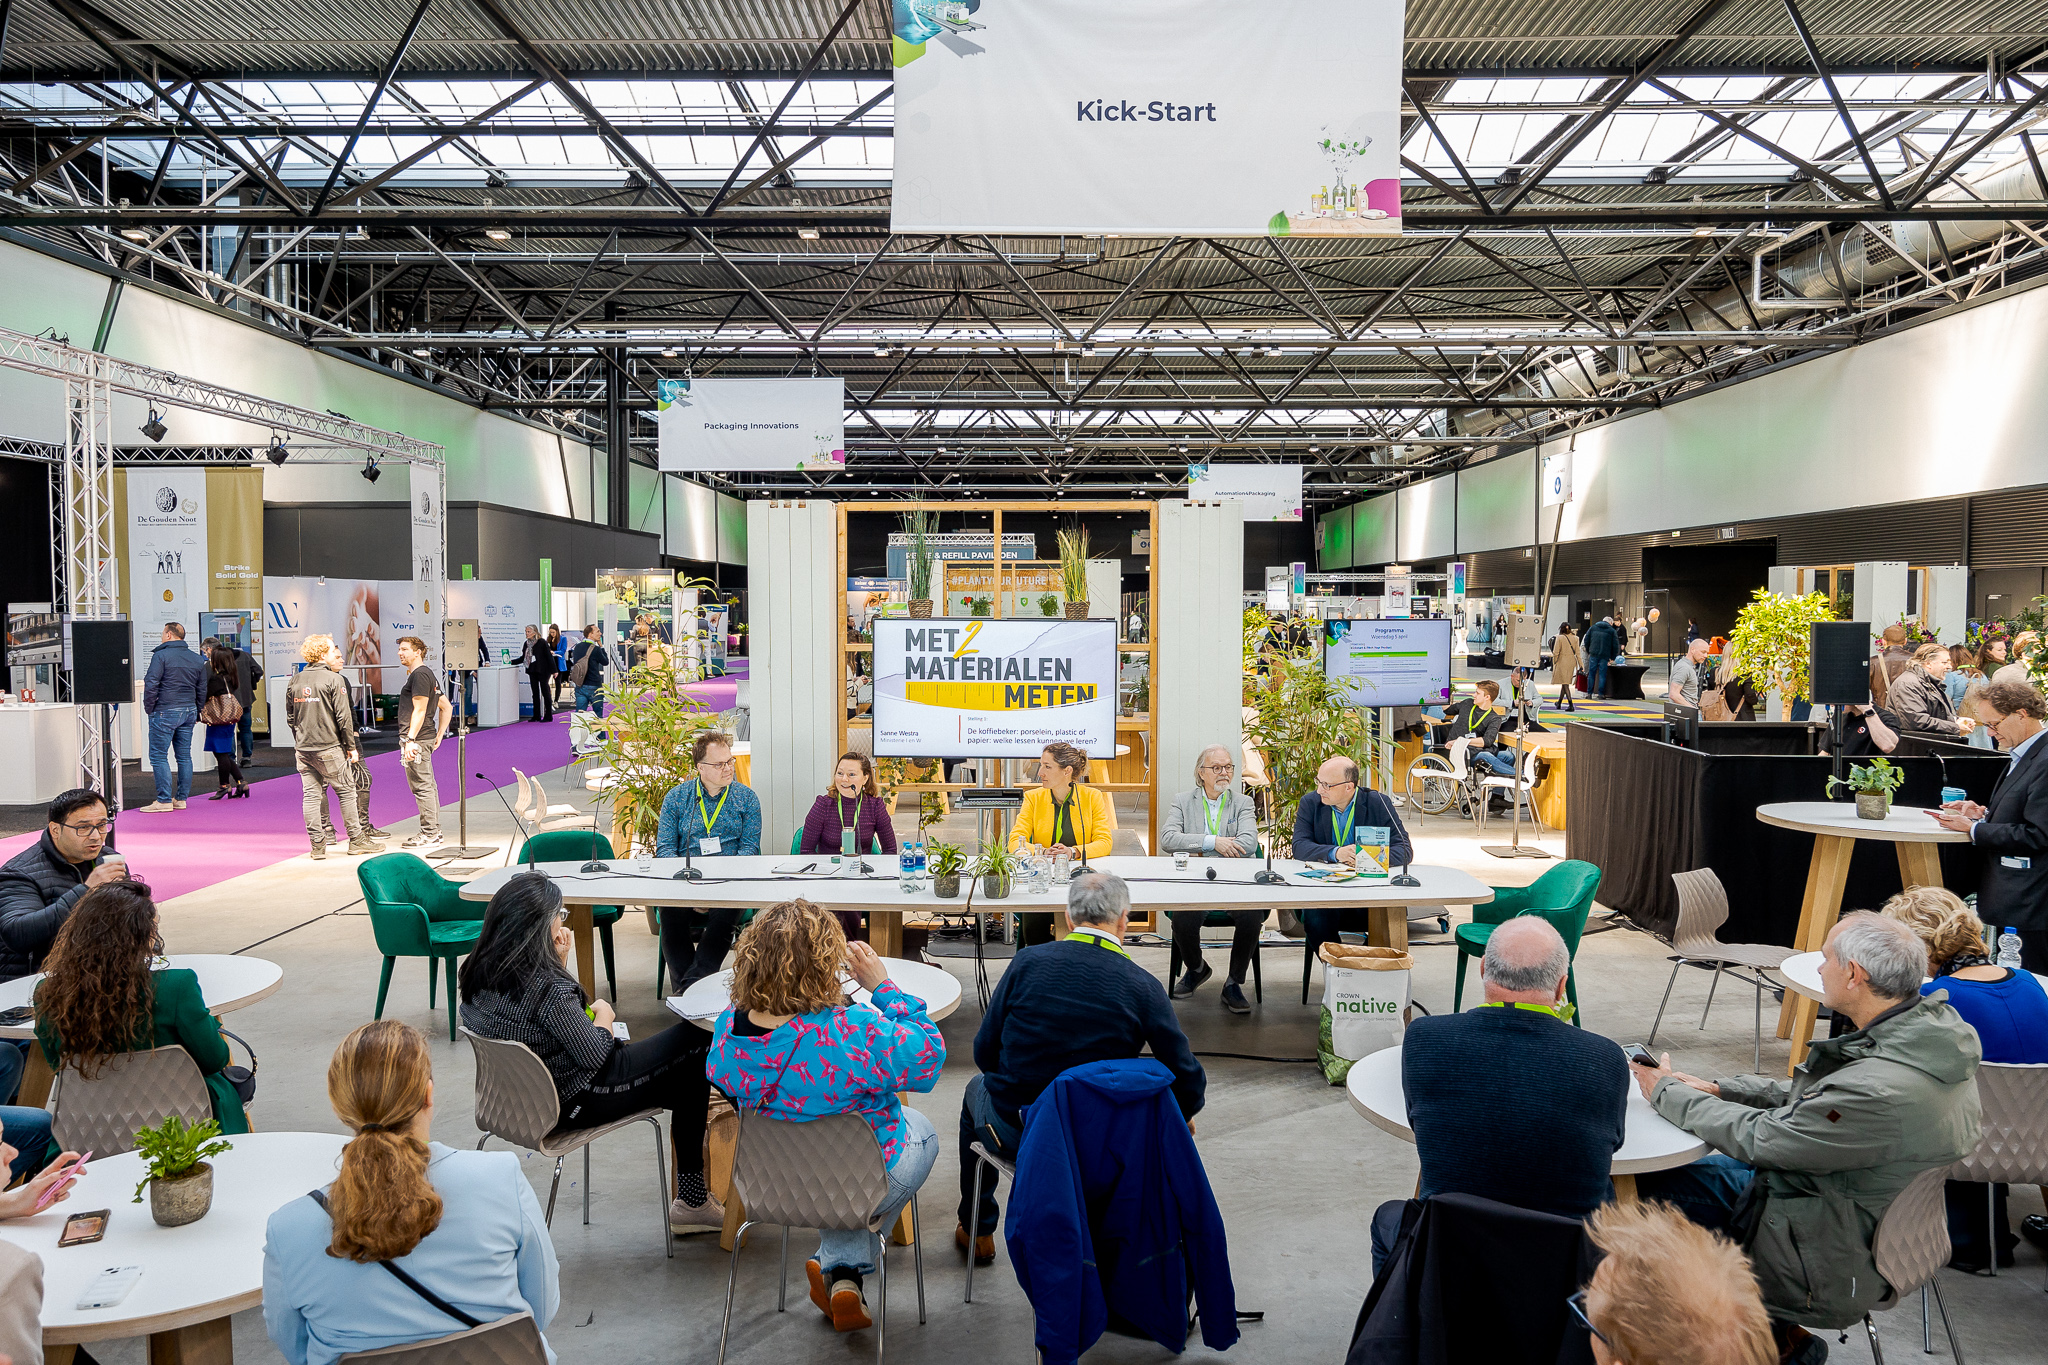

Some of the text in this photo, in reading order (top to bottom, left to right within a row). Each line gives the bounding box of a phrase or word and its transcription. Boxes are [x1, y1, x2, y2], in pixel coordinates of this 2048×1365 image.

[1077, 99, 1217, 122] Kick-Start
[704, 422, 799, 431] Packaging Innovations
[905, 621, 984, 660] MET 2
[905, 656, 1072, 682] MATERIALEN
[978, 727, 1018, 735] koffiebeker:
[1020, 728, 1054, 736] porselein,
[1055, 728, 1077, 736] plastic
[1078, 728, 1087, 736] of
[967, 737, 991, 745] papier:
[1076, 737, 1098, 745] leren?
[1336, 997, 1397, 1013] native
